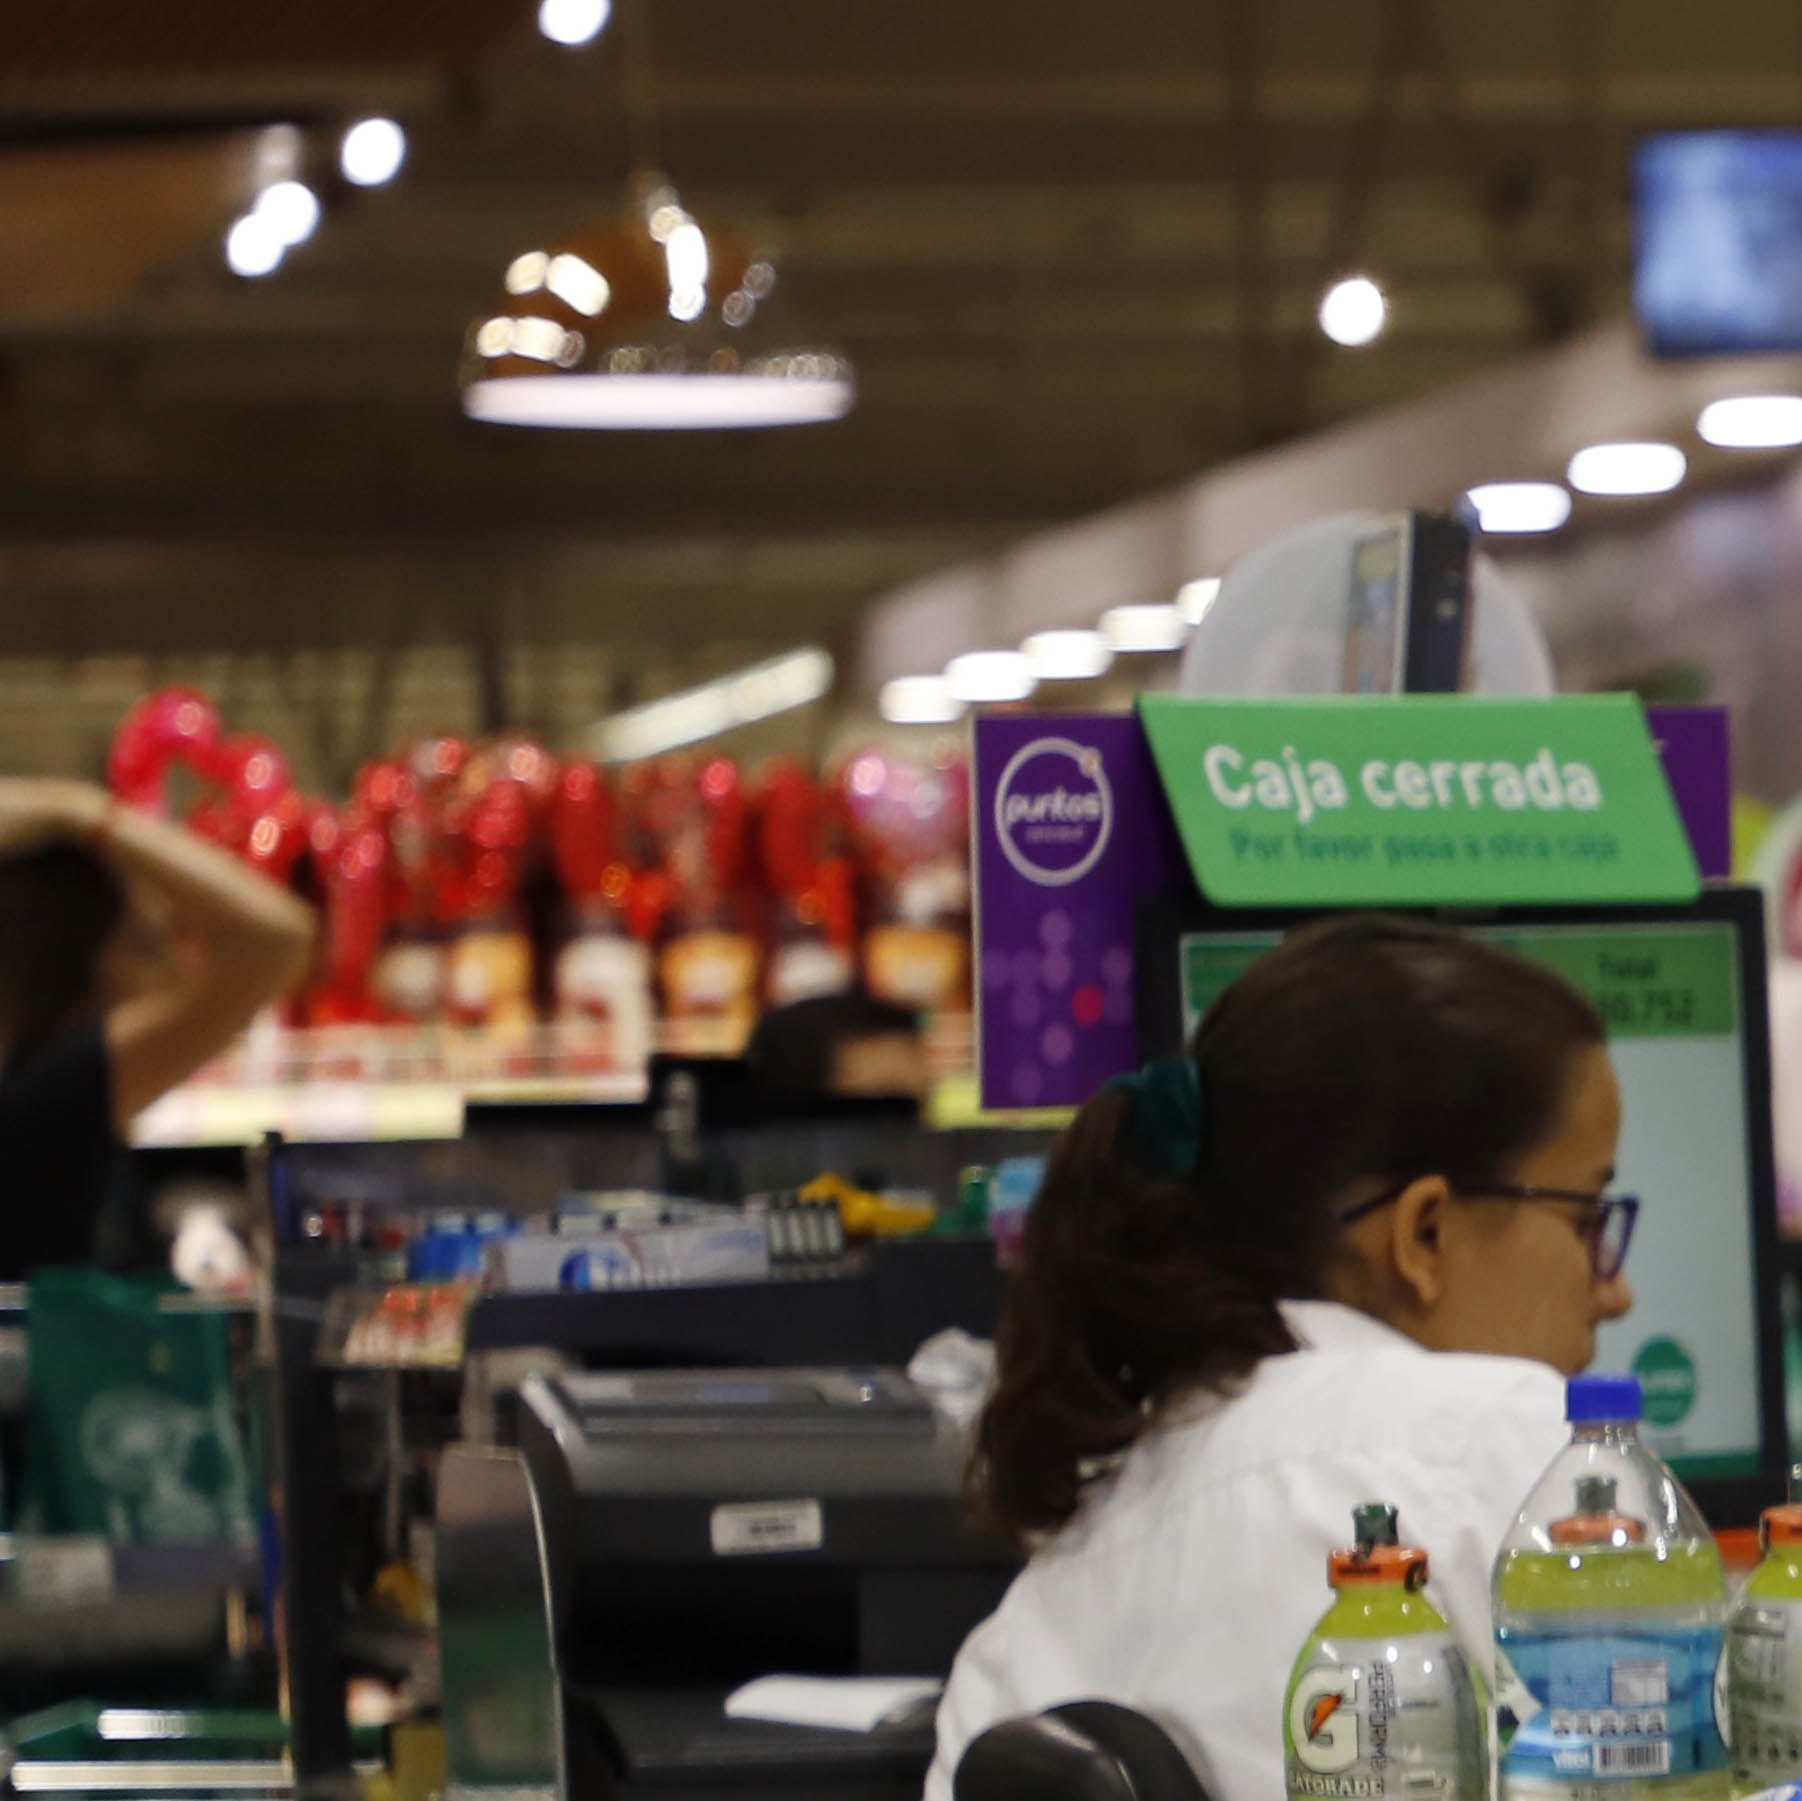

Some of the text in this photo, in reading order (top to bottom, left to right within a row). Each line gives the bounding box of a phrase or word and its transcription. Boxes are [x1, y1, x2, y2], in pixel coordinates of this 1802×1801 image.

[1203, 744, 1602, 824] Caja cerrada
[1295, 1773, 1385, 1800] ATORADE
